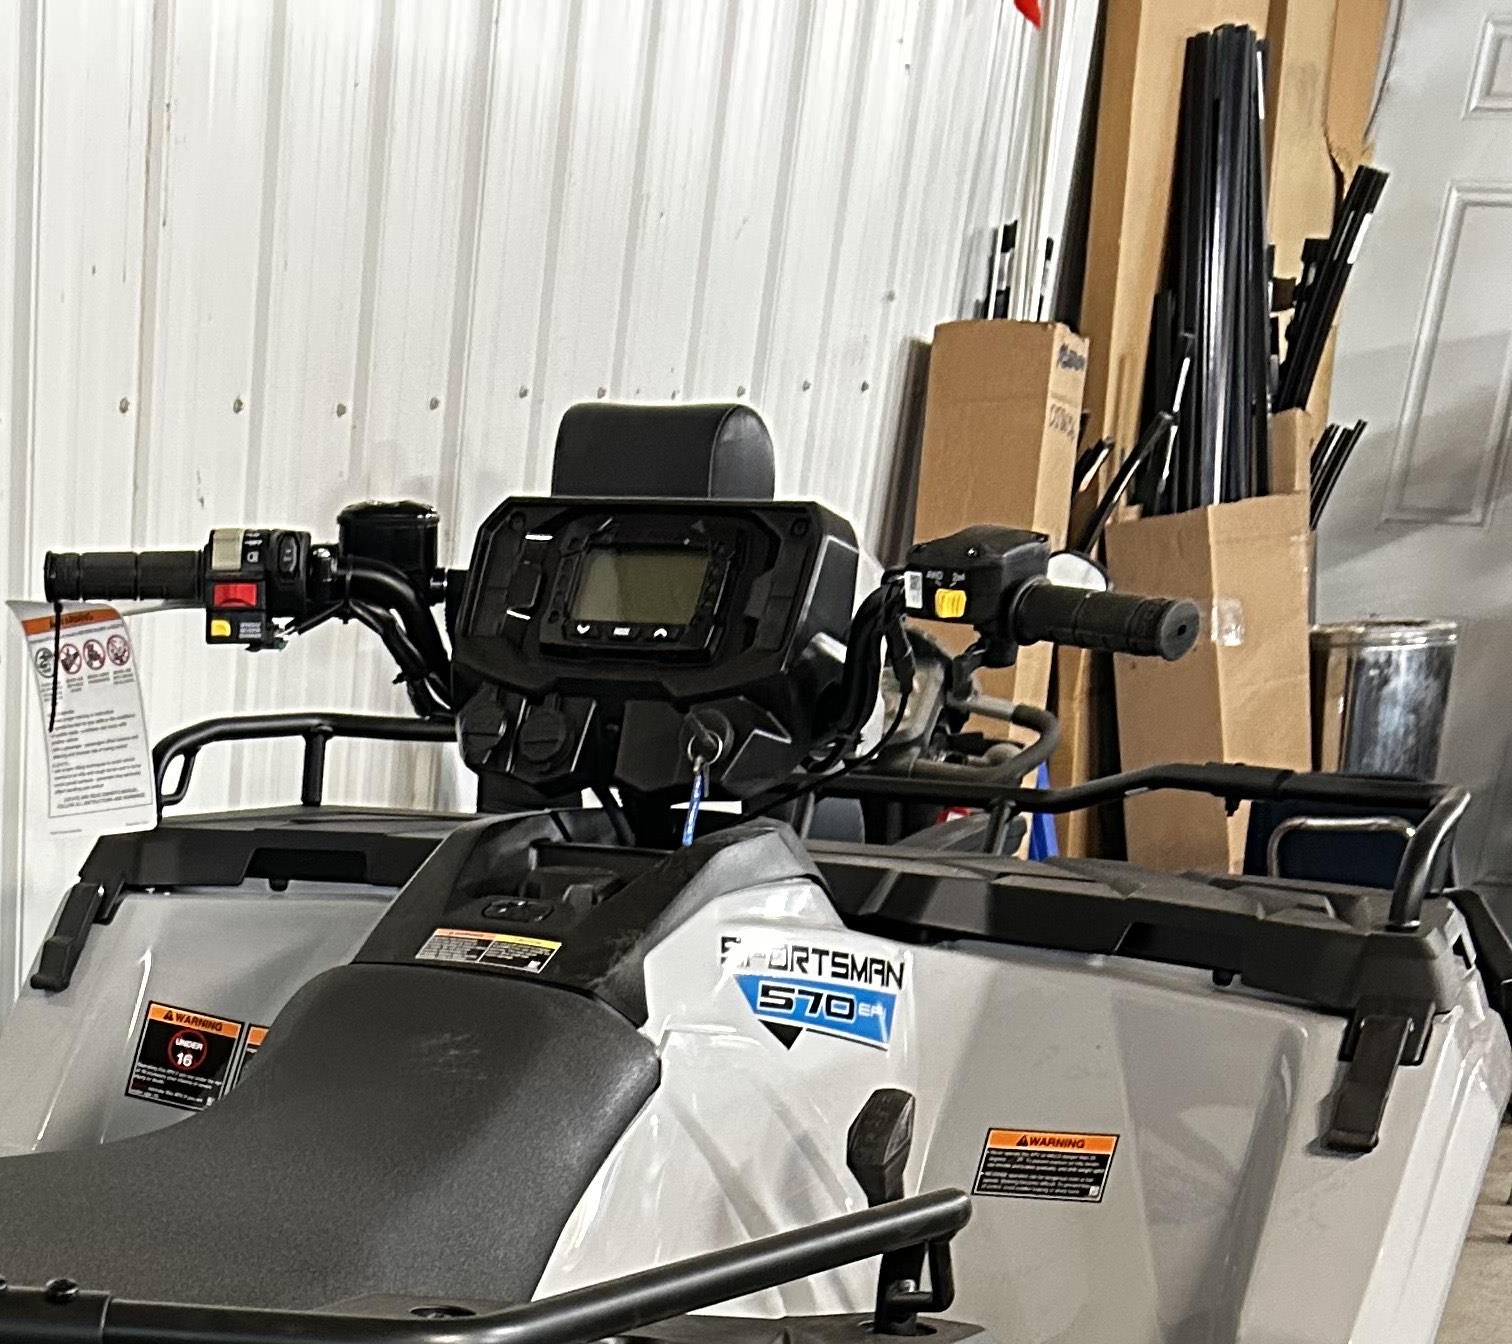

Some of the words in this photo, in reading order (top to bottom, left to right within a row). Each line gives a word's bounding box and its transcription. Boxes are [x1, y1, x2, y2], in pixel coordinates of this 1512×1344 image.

[720, 936, 905, 990] SORTSMAN
[758, 982, 856, 1022] 570
[176, 1011, 223, 1032] WARNING
[175, 1038, 203, 1052] UNDER
[176, 1053, 194, 1068] 16
[1029, 1136, 1086, 1150] WARNING
